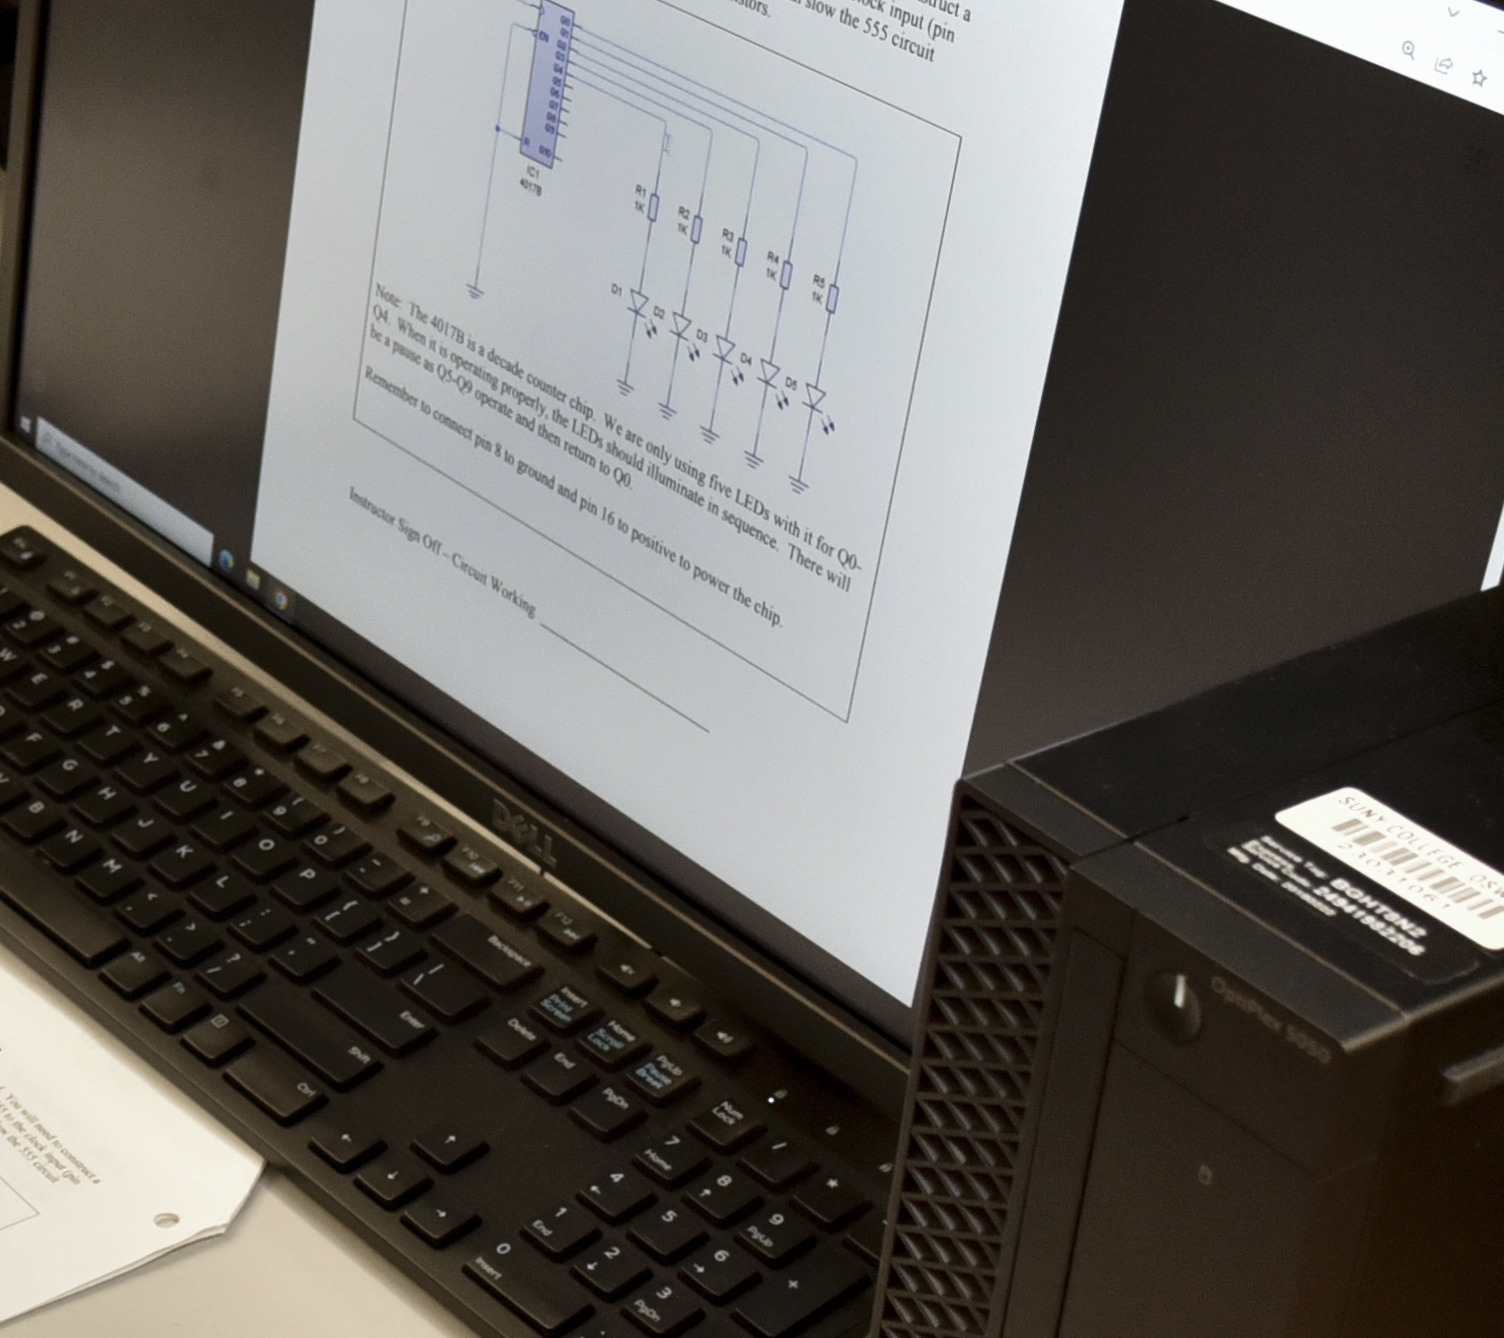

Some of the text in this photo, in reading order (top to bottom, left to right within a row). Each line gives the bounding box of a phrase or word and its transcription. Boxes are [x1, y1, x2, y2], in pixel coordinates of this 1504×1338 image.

[889, 0, 924, 30] input
[927, 17, 955, 43] (pin
[962, 8, 971, 22] a
[839, 7, 859, 29] the
[862, 17, 888, 41] 555
[891, 31, 934, 62] circuit
[492, 799, 558, 868] DELL
[1338, 795, 1386, 824] SUNY
[1386, 824, 1462, 869] COLLEGE
[507, 1018, 536, 1041] Delete
[608, 1020, 635, 1042] Home
[554, 1052, 575, 1069] End
[602, 1087, 629, 1110] PgDn
